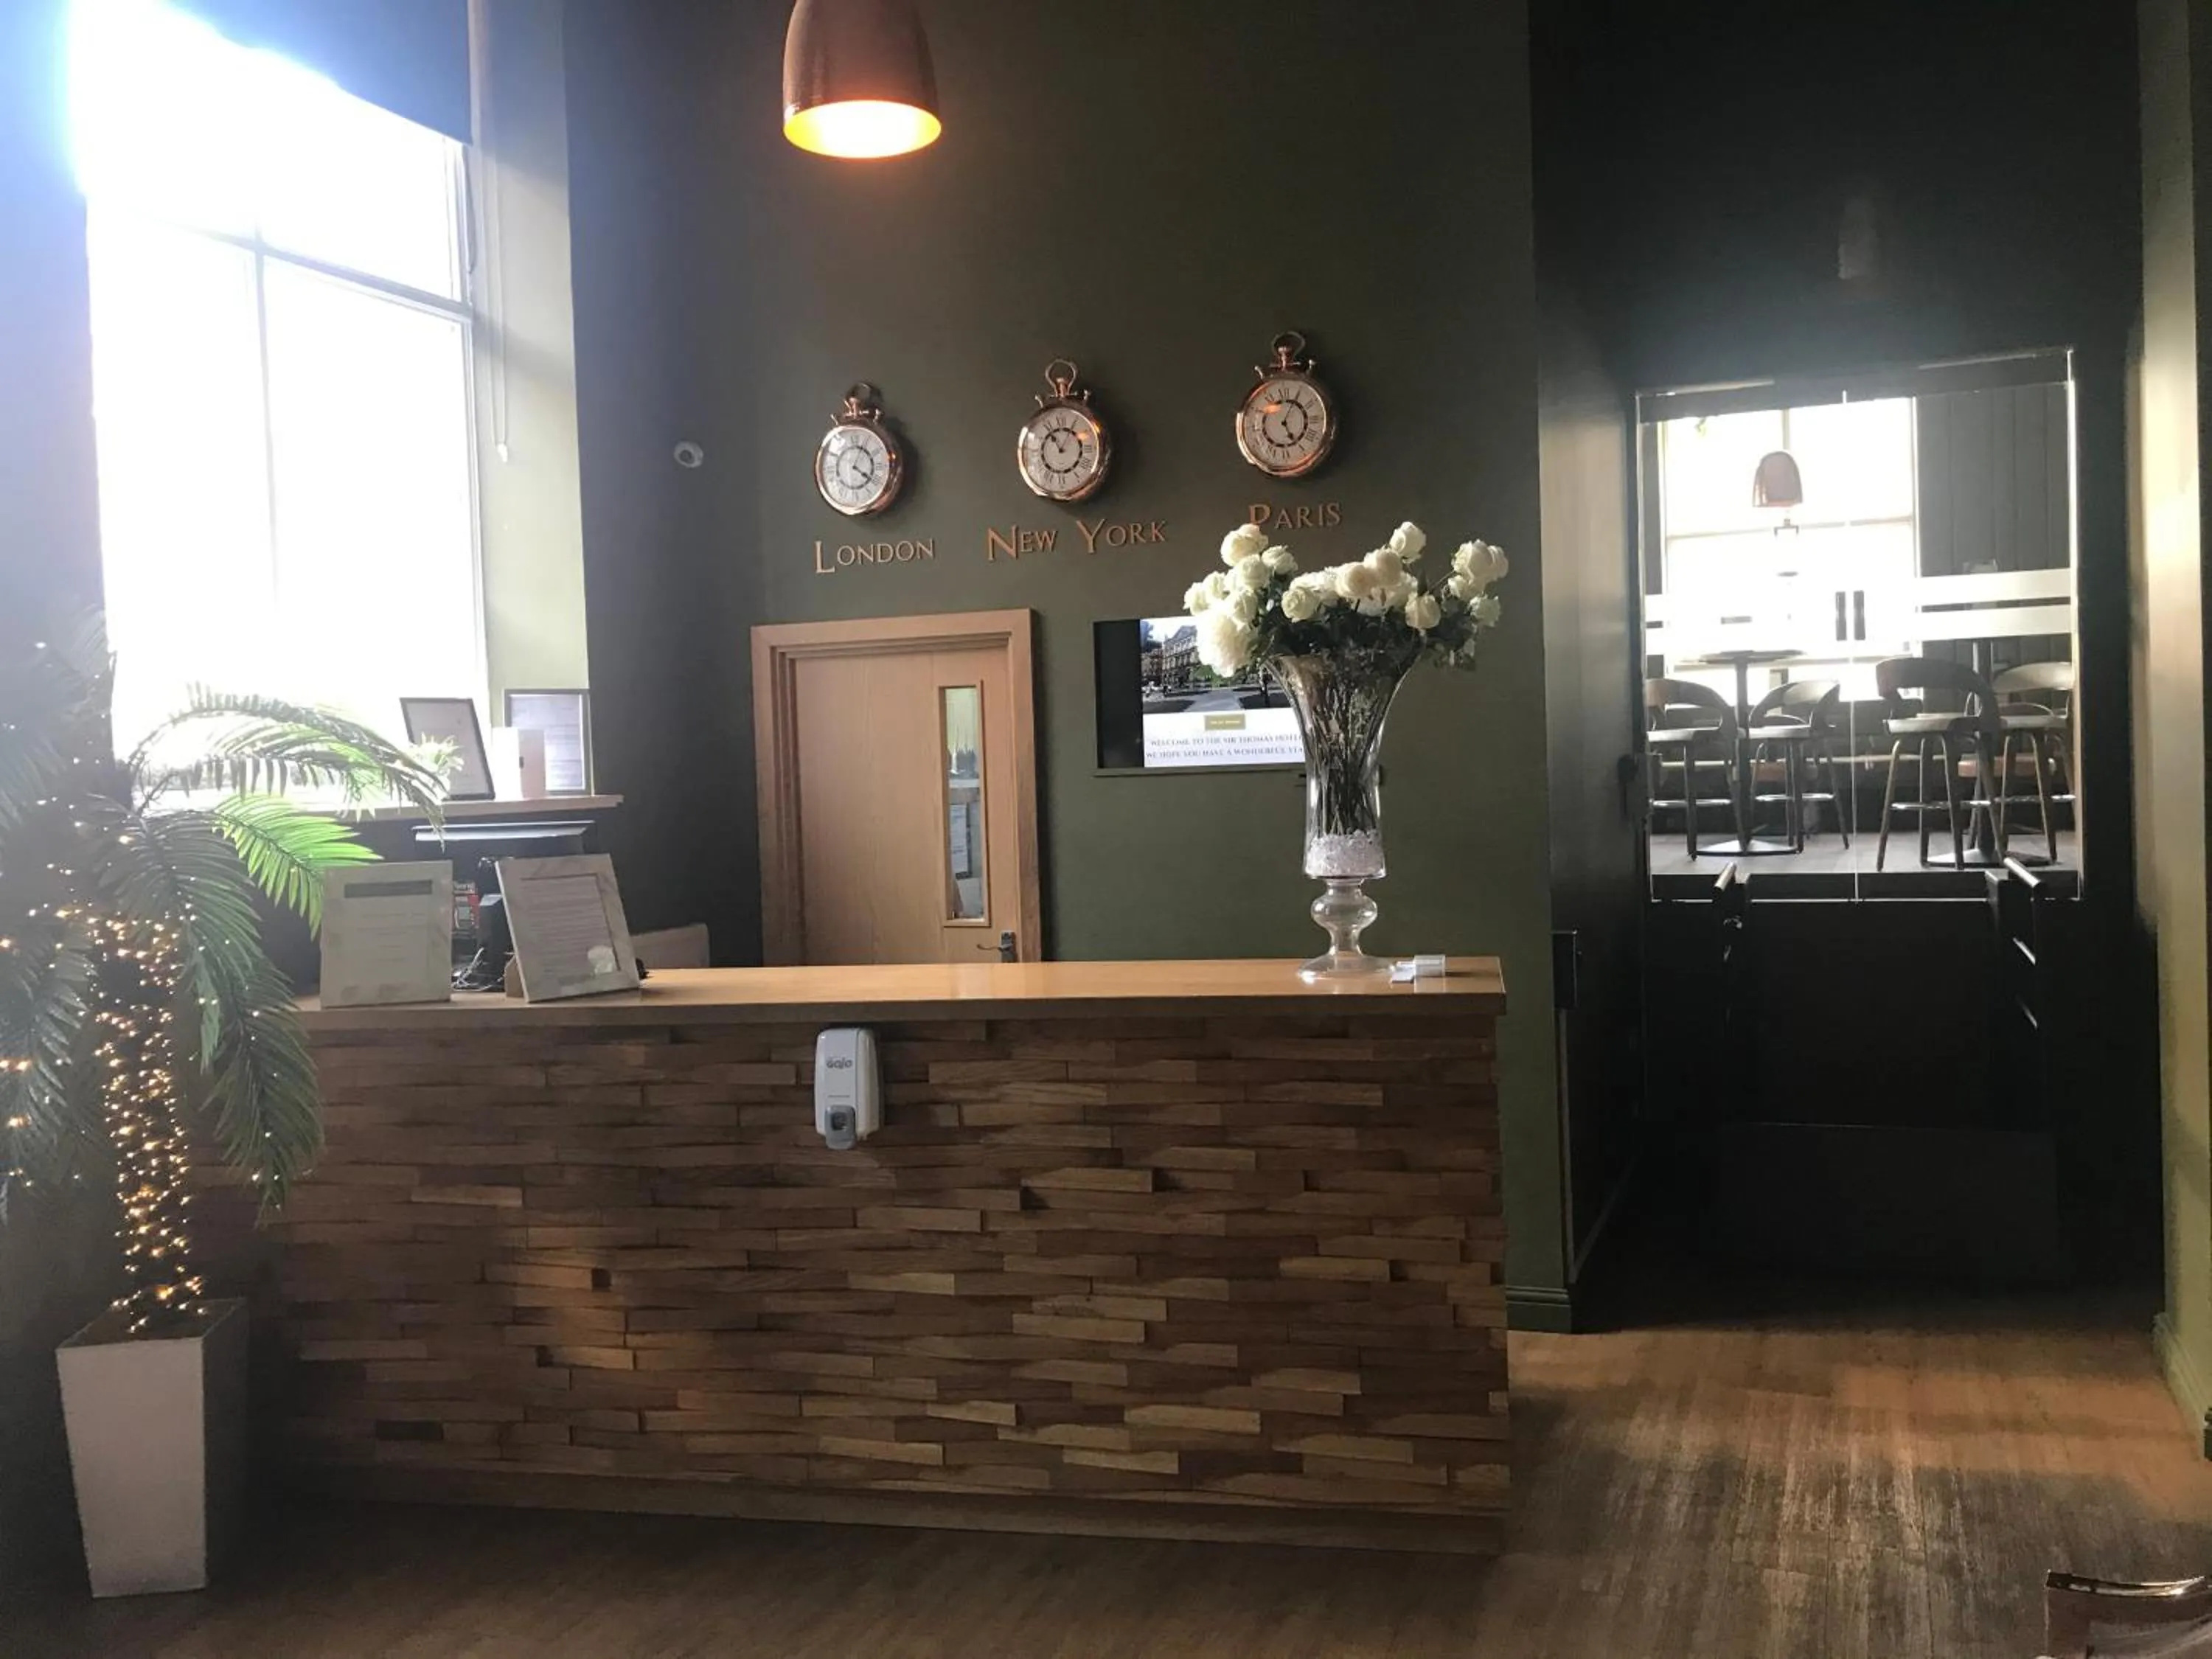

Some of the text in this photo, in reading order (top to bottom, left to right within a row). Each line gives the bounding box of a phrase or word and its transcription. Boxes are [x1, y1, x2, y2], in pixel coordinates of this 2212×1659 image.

[1249, 501, 1340, 529] PARIS
[815, 538, 934, 574] LONDON
[987, 518, 1166, 561] NEW YORK
